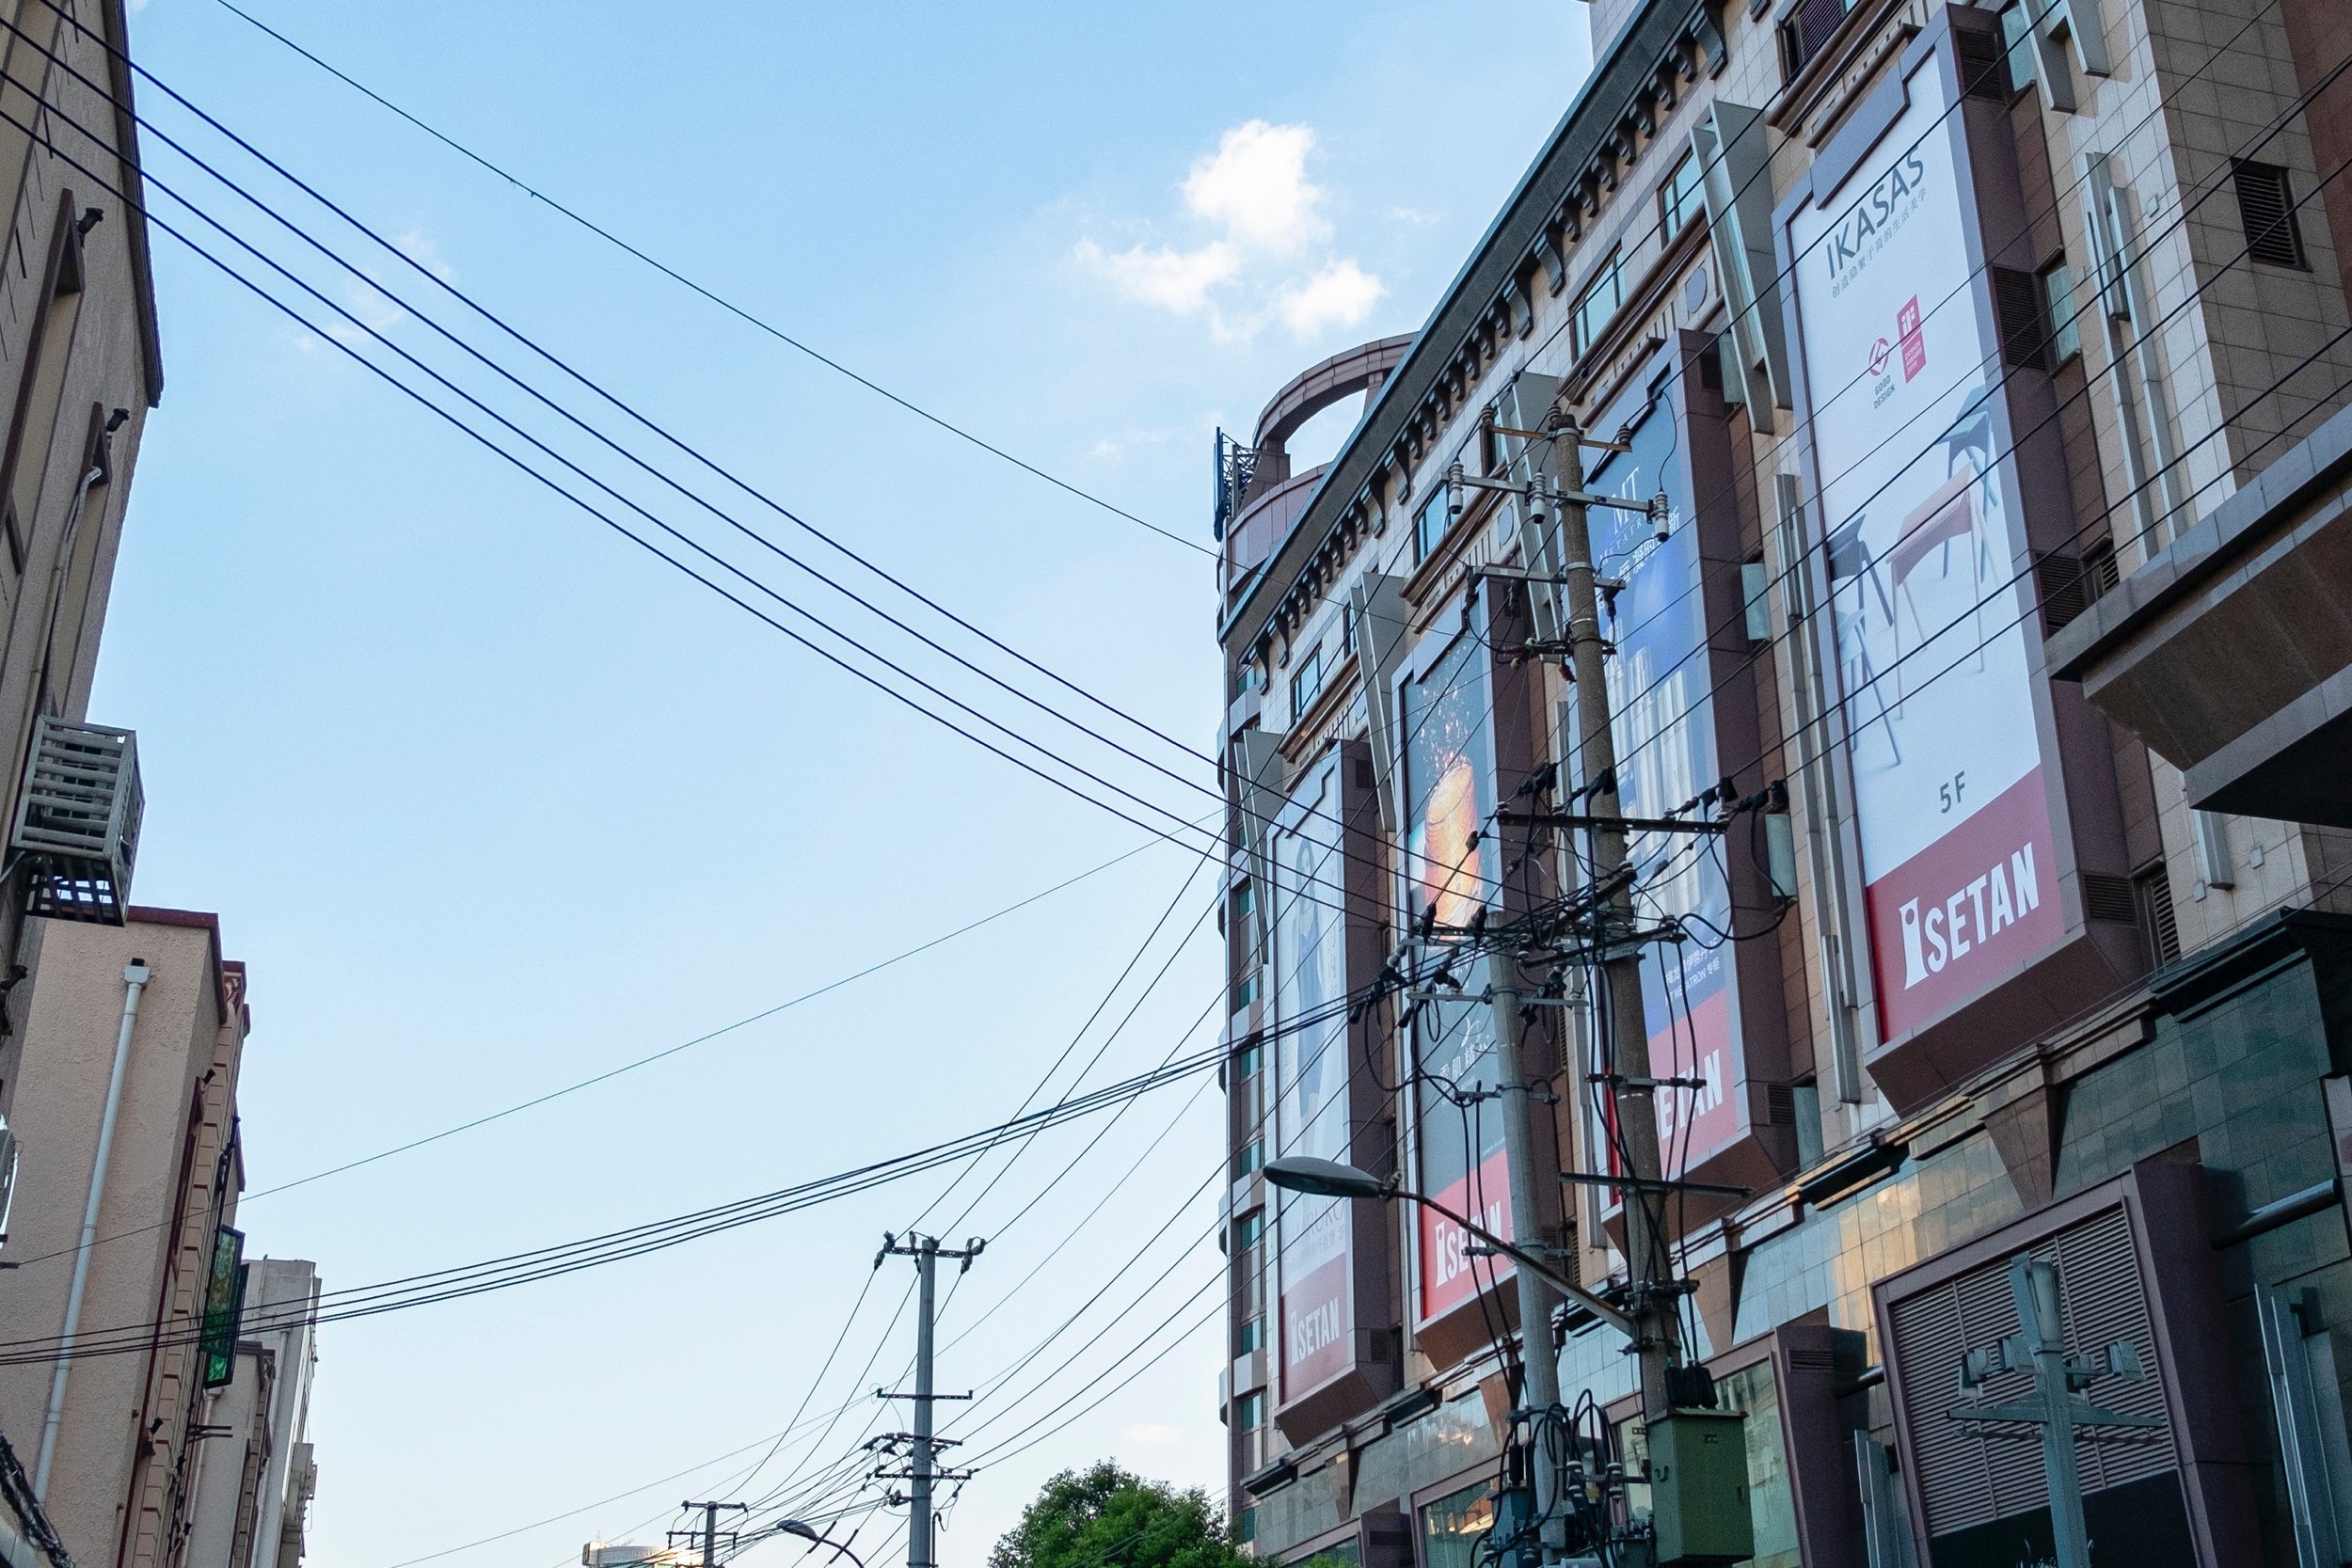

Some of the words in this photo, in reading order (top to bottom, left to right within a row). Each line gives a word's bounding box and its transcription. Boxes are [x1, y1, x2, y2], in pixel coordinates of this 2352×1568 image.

[1826, 144, 1924, 280] IKASAS
[1873, 384, 1896, 409] DESIGN
[1874, 374, 1892, 396] GOOD
[1939, 770, 1966, 814] 5F
[1899, 842, 2040, 990] ISETAN
[1653, 1049, 1723, 1140] ETAN
[1290, 1296, 1340, 1367] ISETAN
